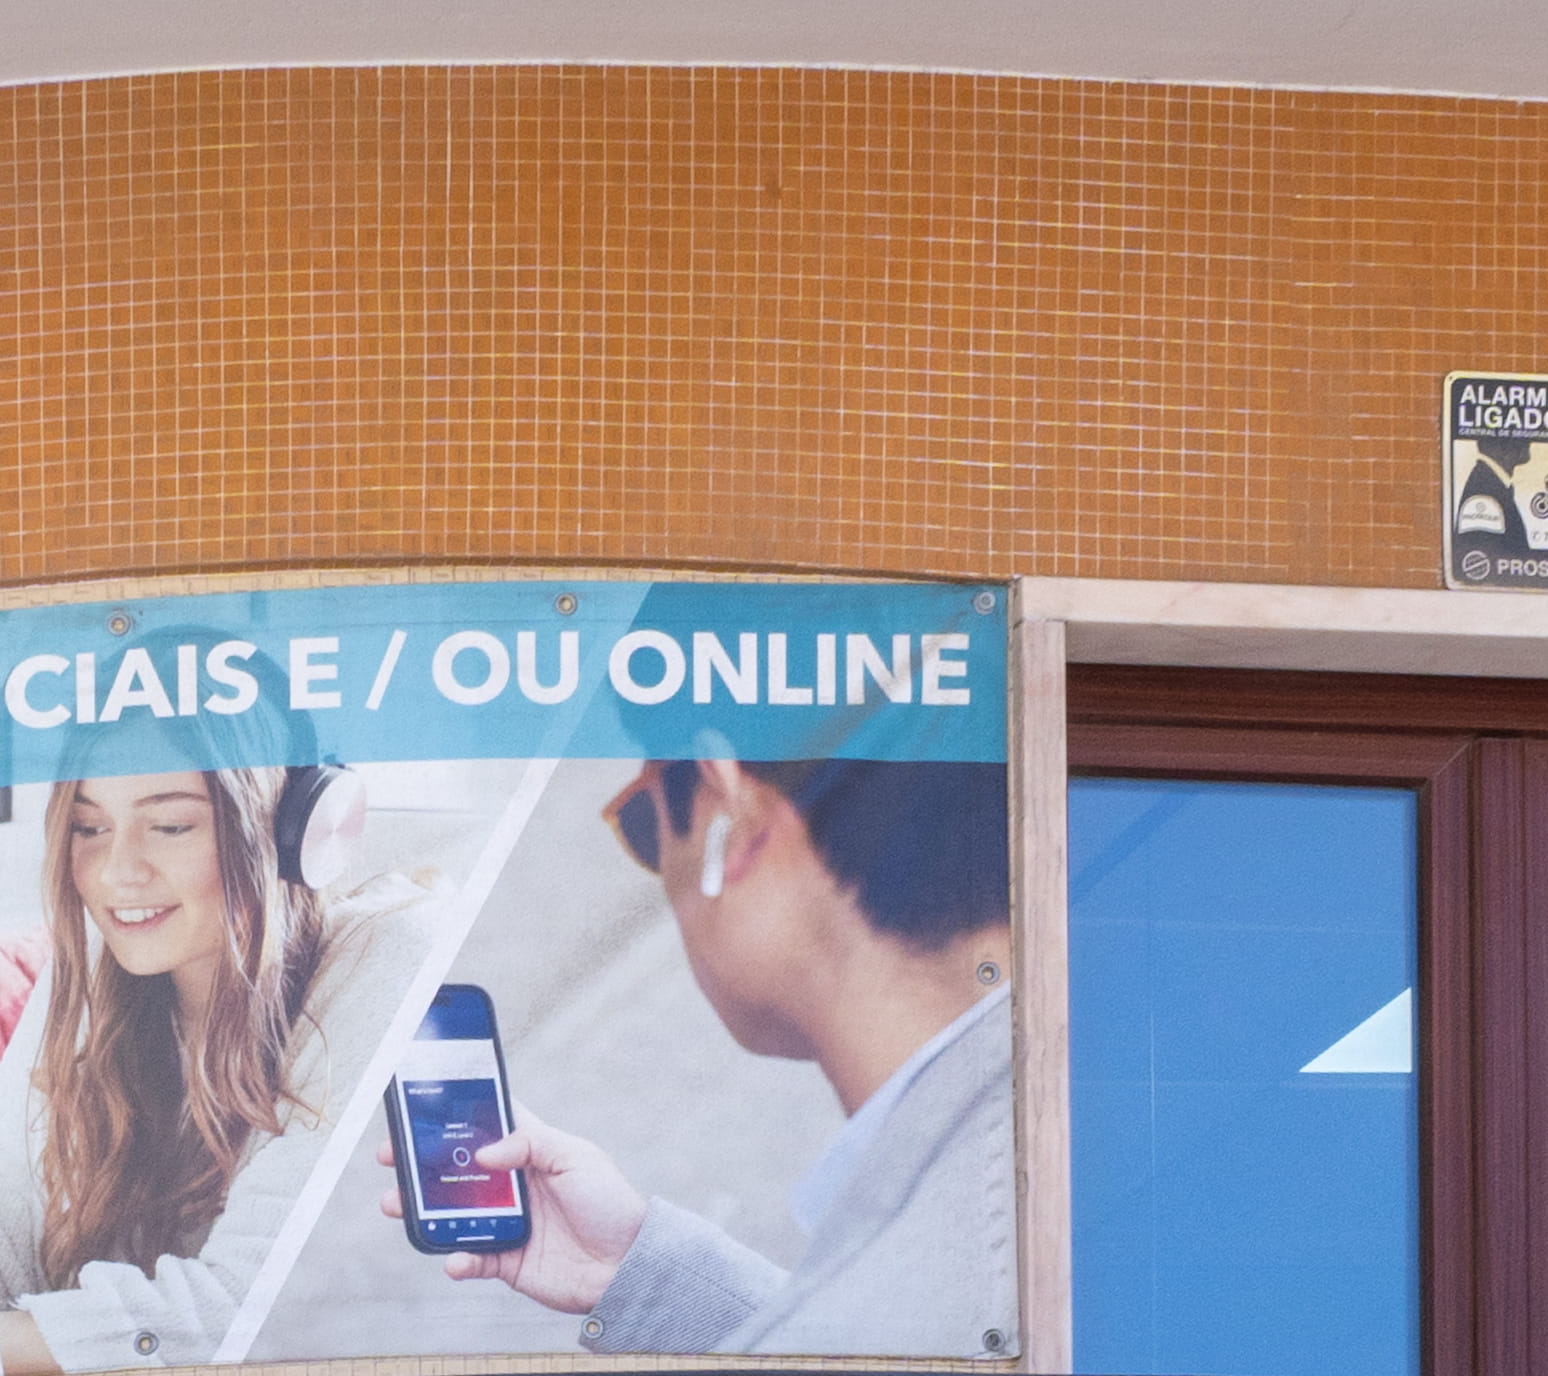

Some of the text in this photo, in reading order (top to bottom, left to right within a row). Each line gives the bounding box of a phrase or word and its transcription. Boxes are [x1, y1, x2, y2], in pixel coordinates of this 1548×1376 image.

[288, 636, 342, 711] E
[365, 630, 408, 711] /
[431, 628, 580, 706] OU
[608, 628, 972, 706] ONLINE
